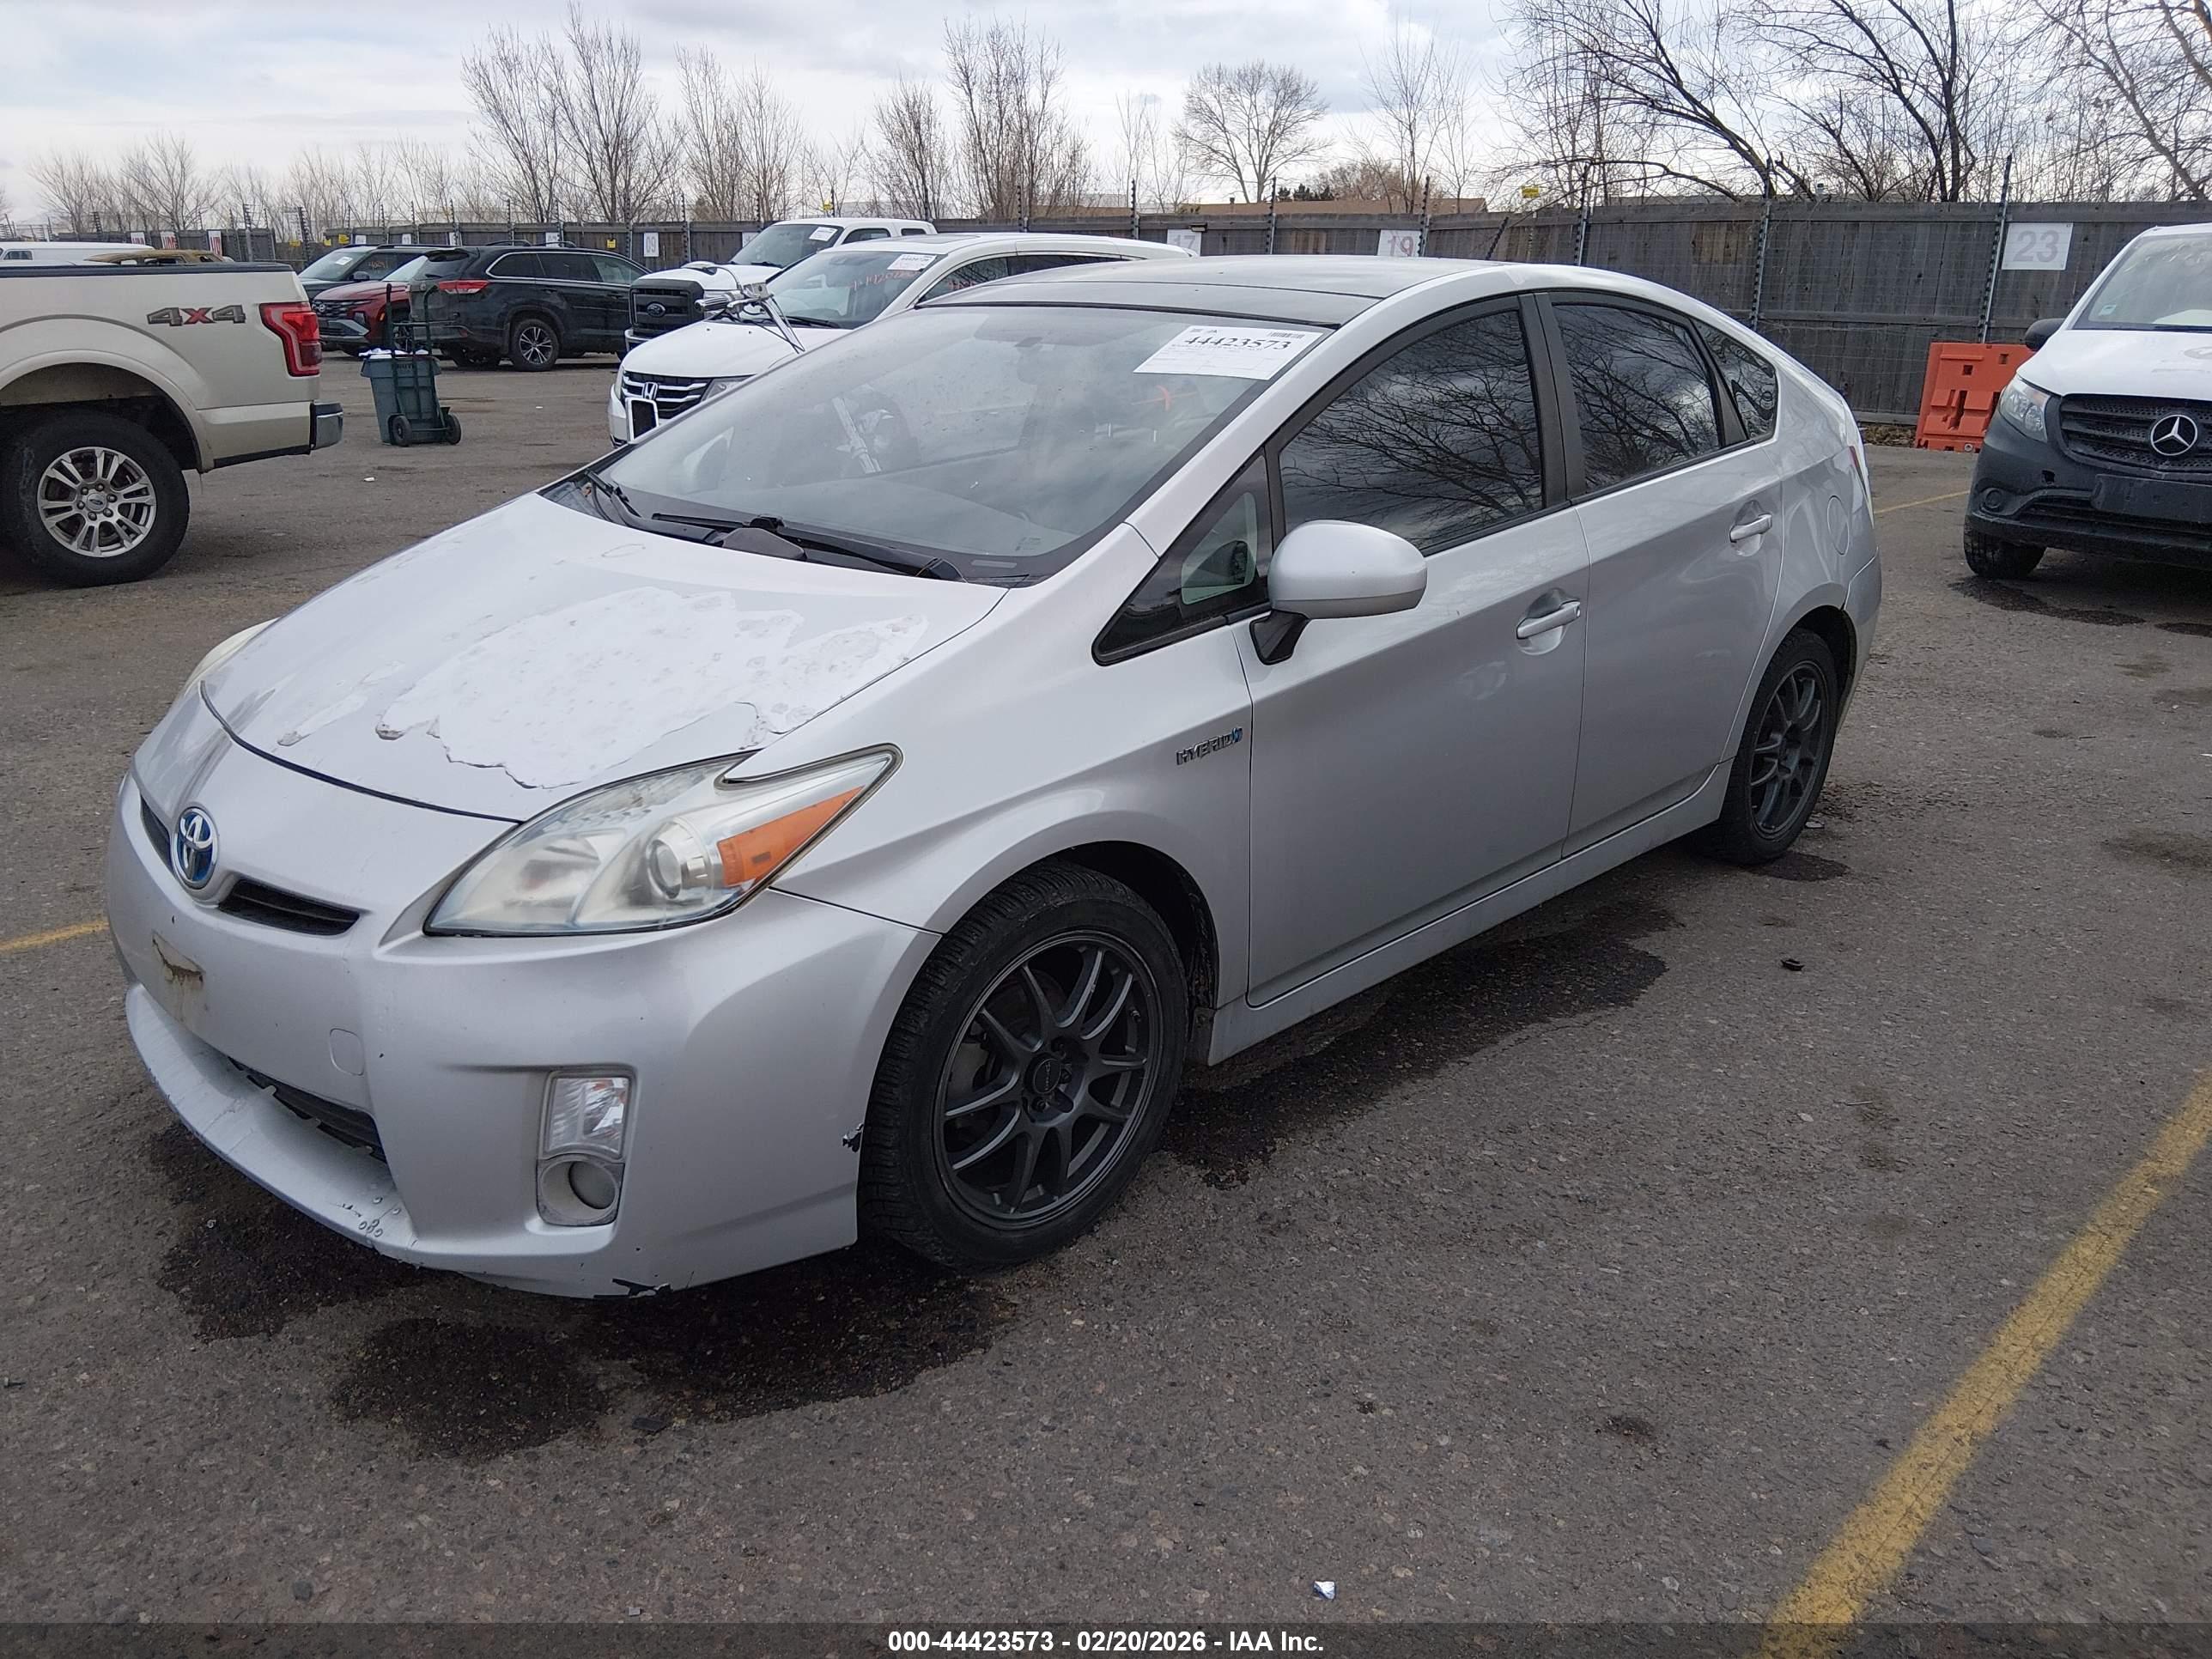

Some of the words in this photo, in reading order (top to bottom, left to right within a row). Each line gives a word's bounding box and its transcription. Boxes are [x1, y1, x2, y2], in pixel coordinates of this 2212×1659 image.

[645, 236, 657, 253] 09
[1173, 234, 1197, 250] 17
[1387, 234, 1415, 257] 19
[2013, 230, 2060, 263] 23
[1183, 336, 1291, 351] 44423573
